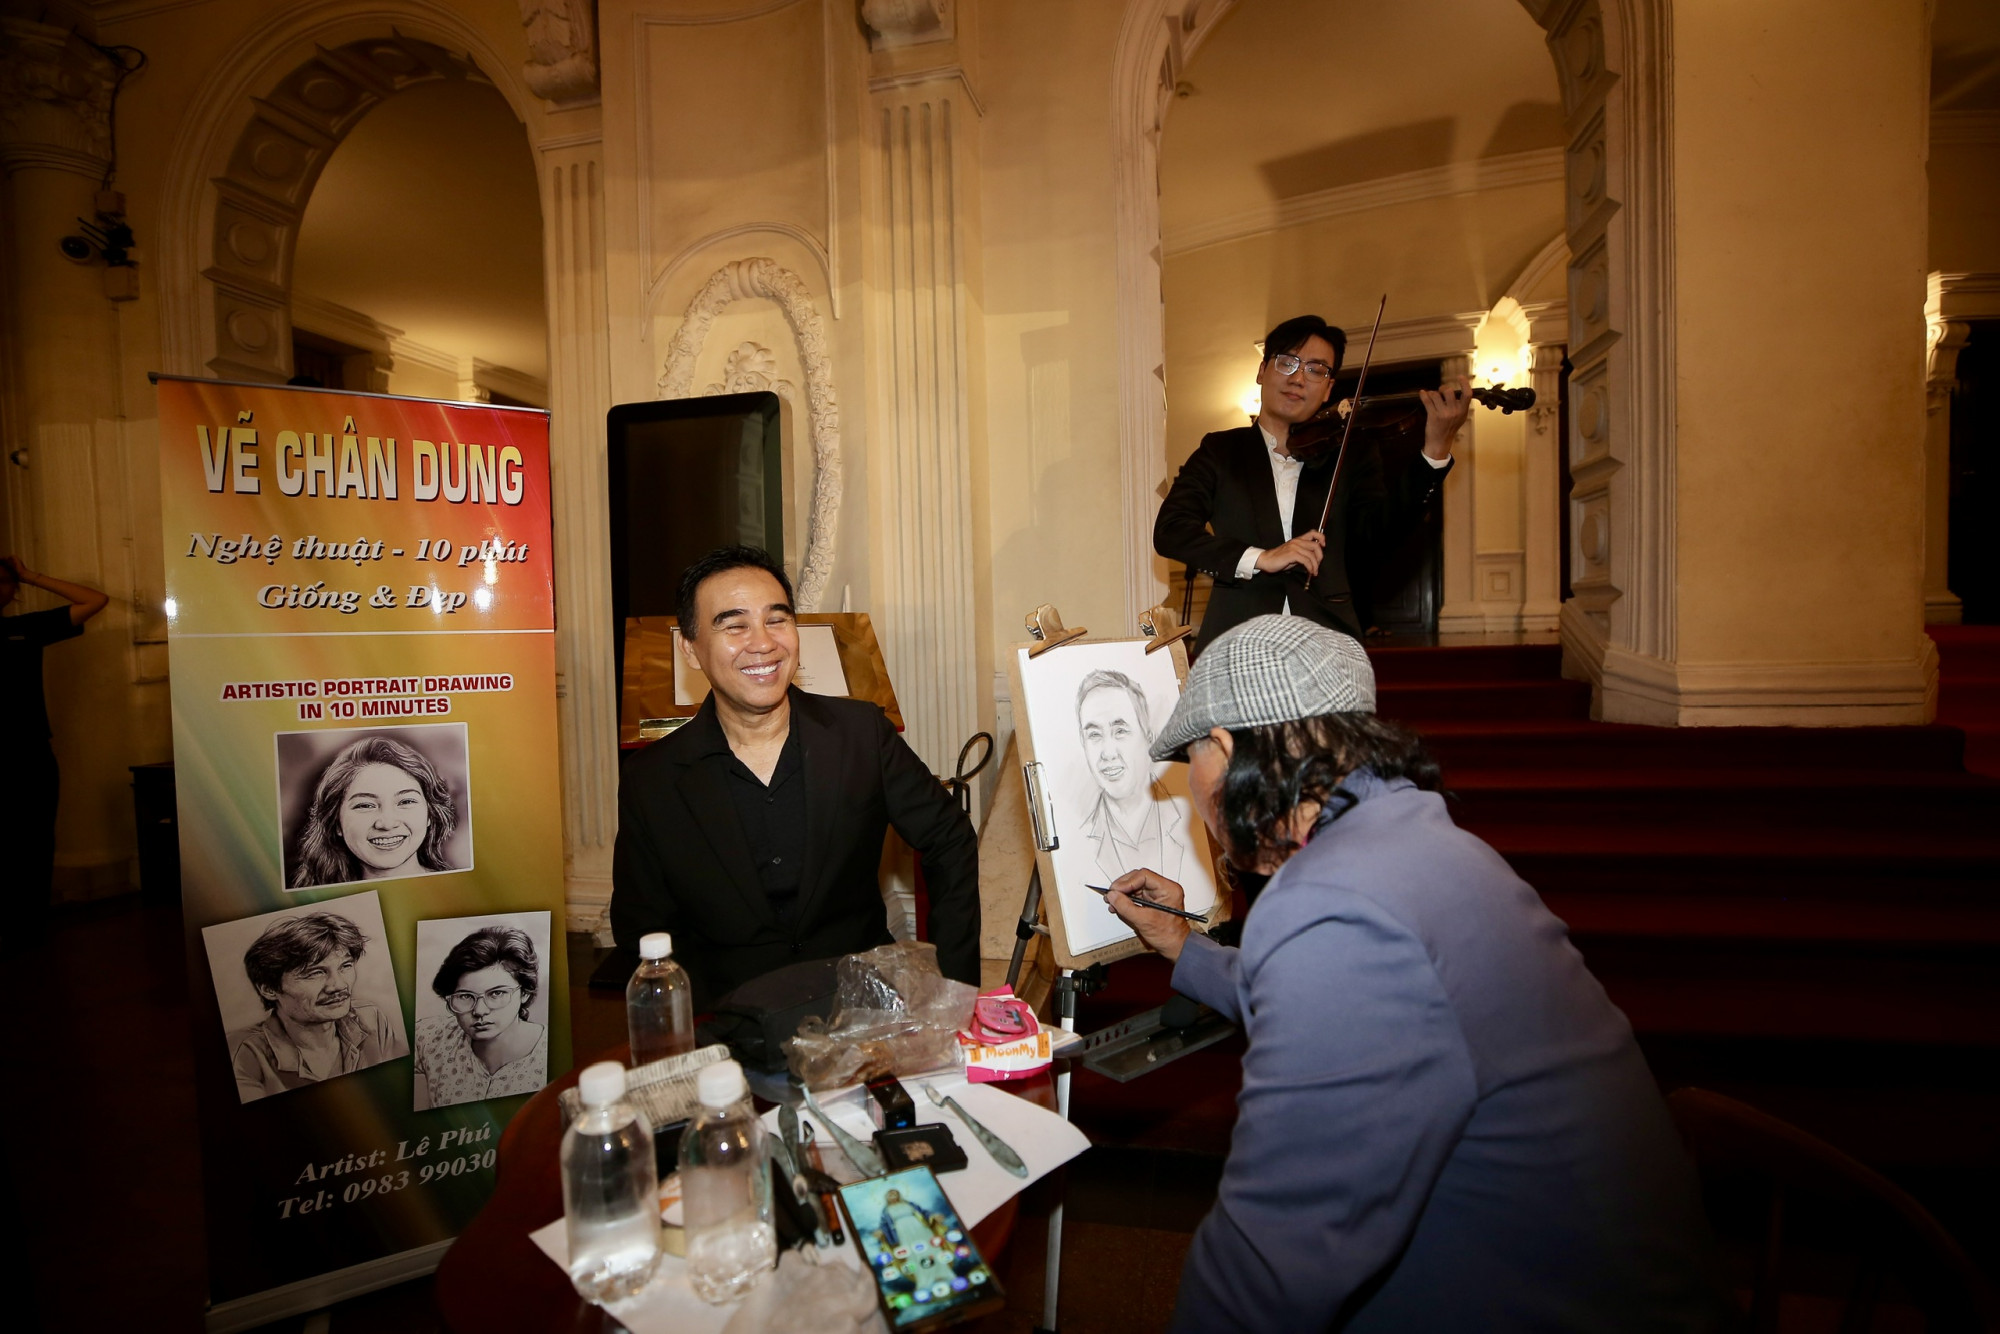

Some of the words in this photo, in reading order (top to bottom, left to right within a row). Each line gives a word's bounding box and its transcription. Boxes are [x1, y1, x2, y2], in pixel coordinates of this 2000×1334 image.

[196, 410, 259, 494] VẼ
[275, 415, 398, 499] CHÂN
[412, 439, 525, 505] DUNG
[185, 532, 283, 568] Nghệ
[291, 535, 384, 567] thuật
[414, 537, 452, 562] 10
[458, 539, 529, 567] phút
[256, 581, 360, 614] Giống
[368, 585, 398, 610] &
[222, 681, 317, 700] ARTISTIC
[323, 678, 419, 696] PORTRAIT
[425, 675, 512, 693] DRAWING
[299, 703, 322, 719] IN
[330, 702, 355, 718] 10
[361, 697, 449, 717] MINUTES
[295, 1149, 386, 1185] Artist:
[394, 1135, 431, 1162] Lê
[437, 1121, 492, 1151] Phú
[277, 1190, 334, 1220] Tel:
[343, 1171, 409, 1203] 0983
